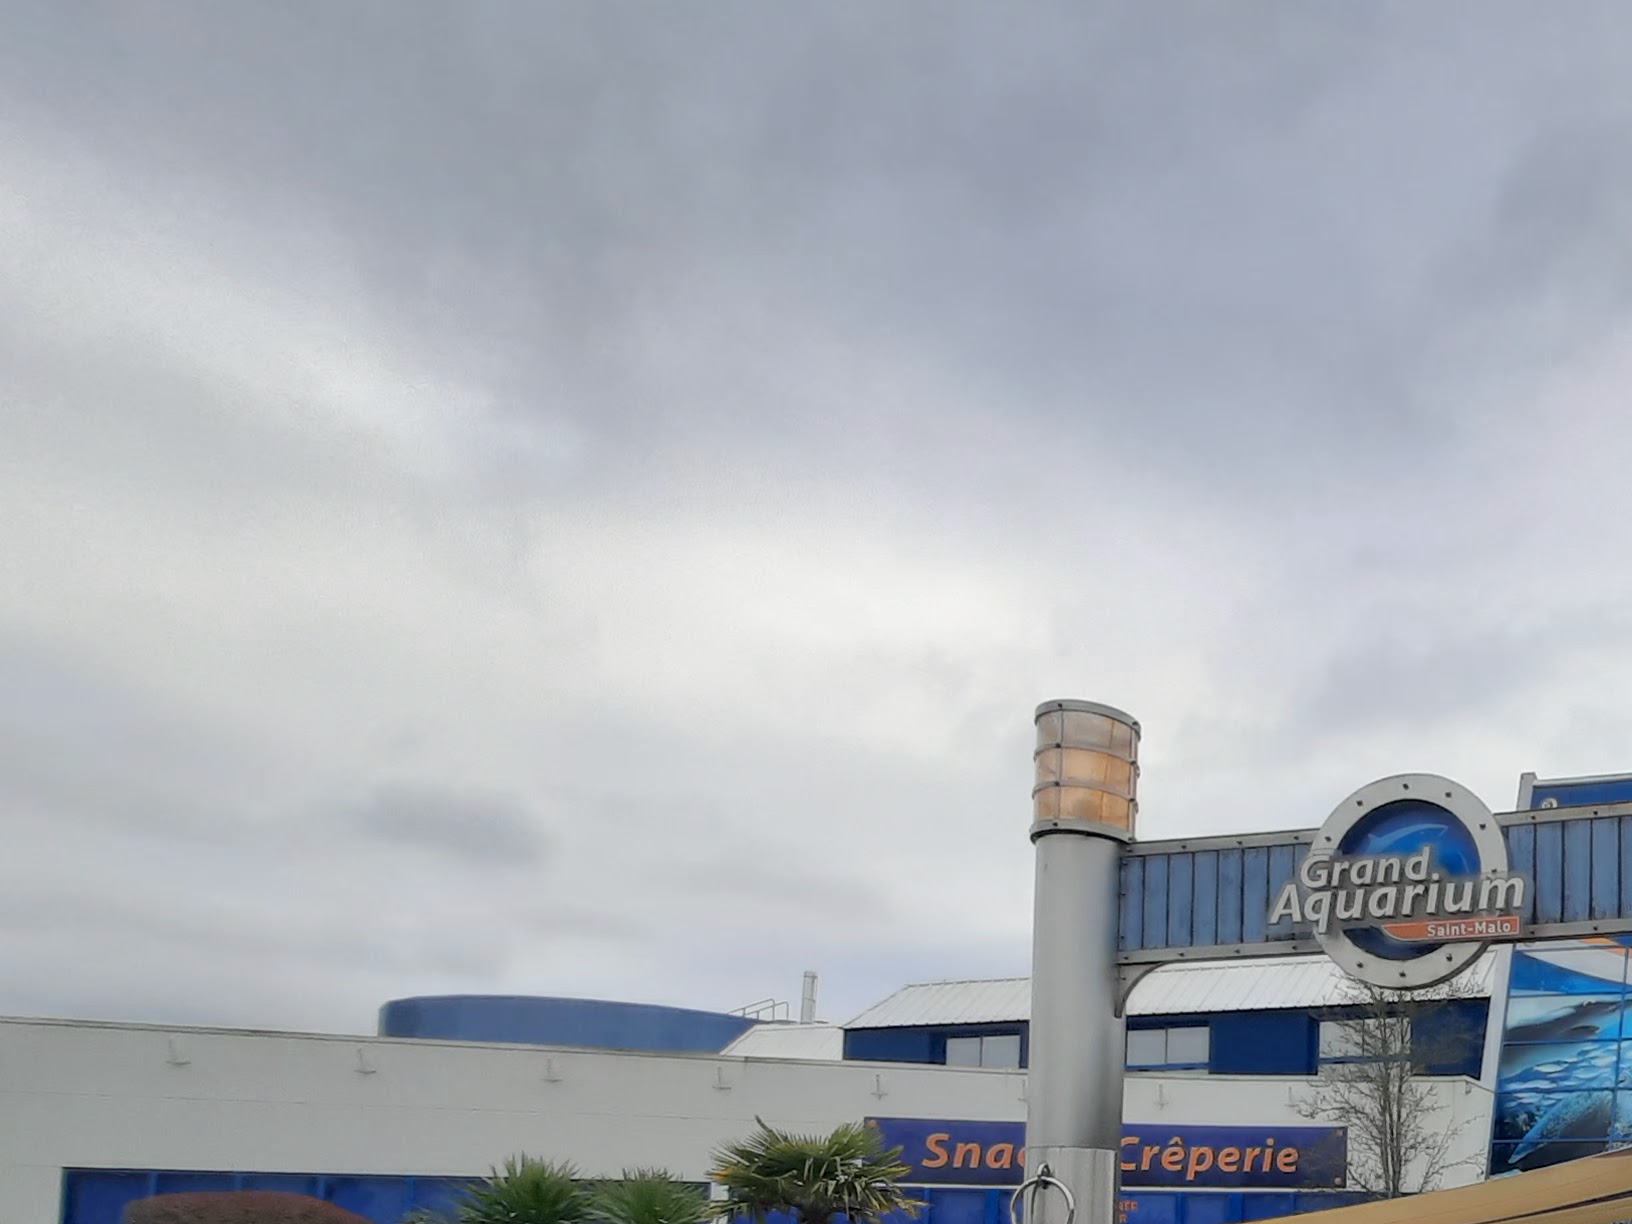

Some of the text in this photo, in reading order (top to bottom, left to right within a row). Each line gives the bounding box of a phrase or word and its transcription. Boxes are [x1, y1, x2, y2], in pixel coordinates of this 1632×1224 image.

[1300, 846, 1431, 889] Grand
[1268, 872, 1525, 934] Aquarium
[1426, 920, 1512, 937] Saint-Malo
